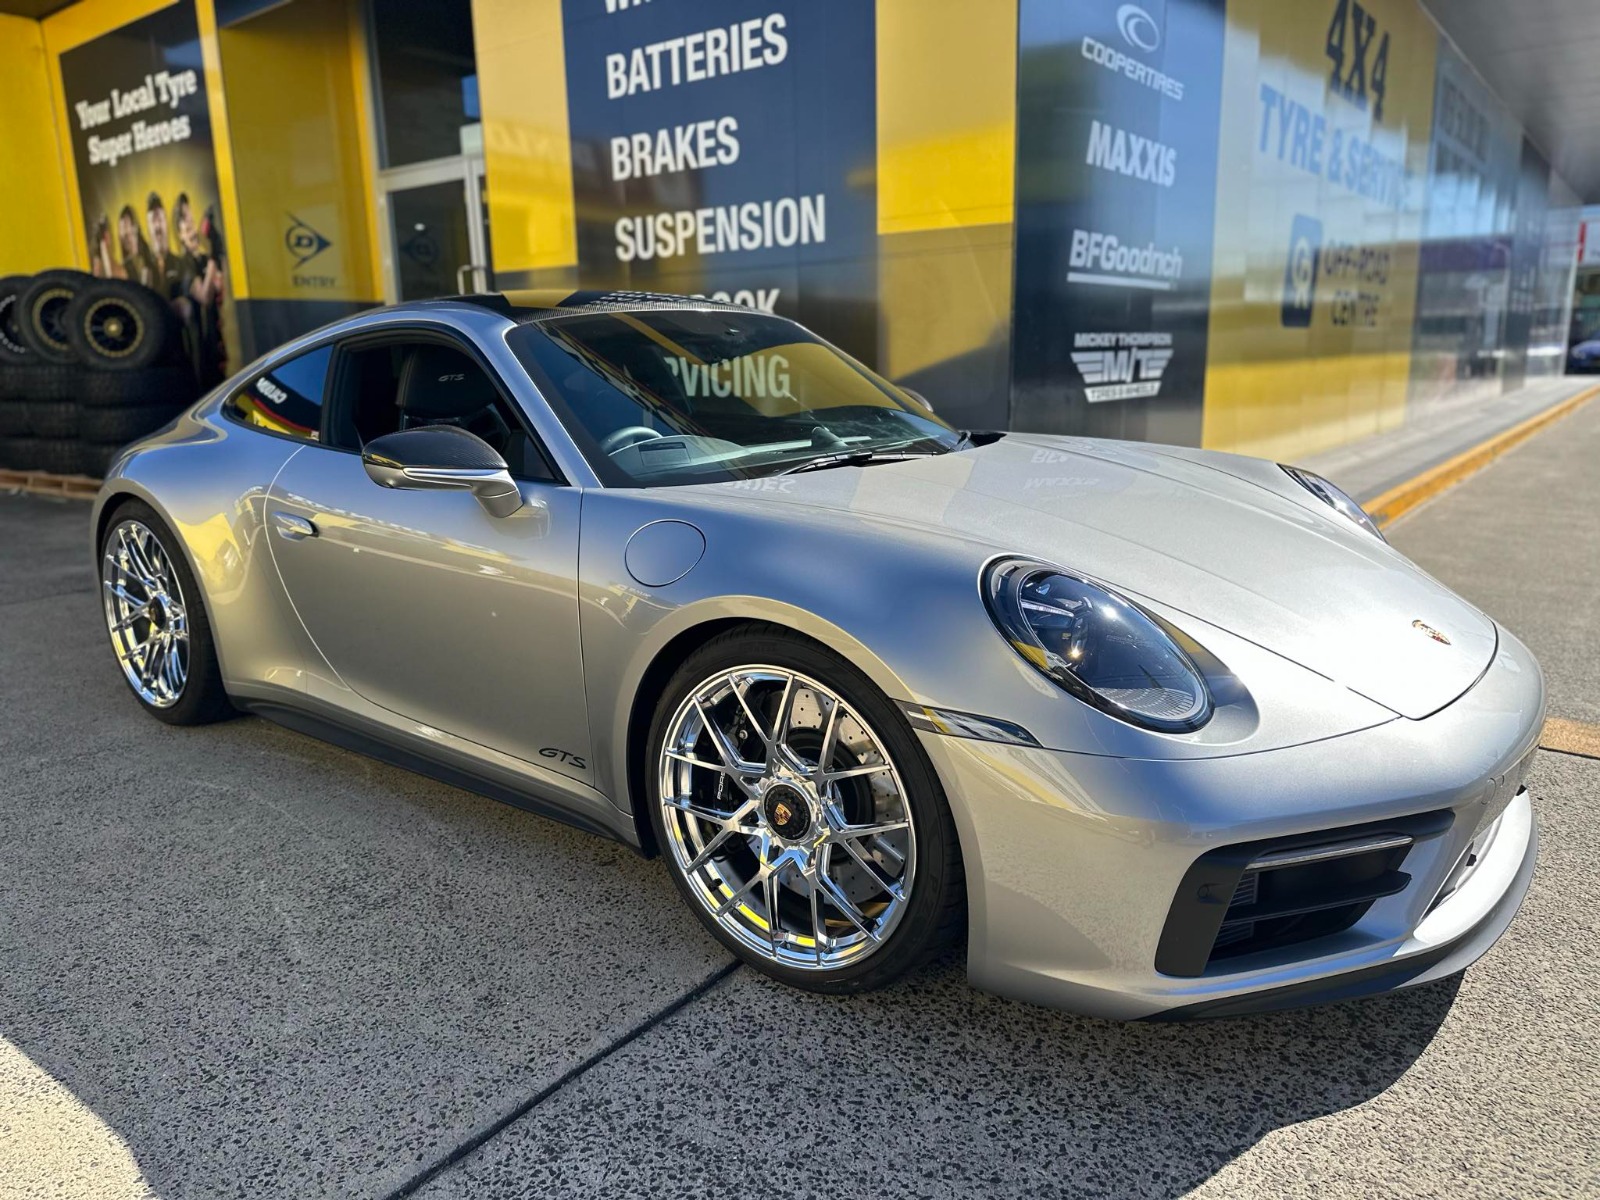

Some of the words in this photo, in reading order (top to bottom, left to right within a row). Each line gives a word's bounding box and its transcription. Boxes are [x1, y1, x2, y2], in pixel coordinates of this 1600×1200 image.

[605, 12, 788, 100] BATTERIES
[75, 100, 112, 130] Your
[110, 74, 157, 119] Local
[154, 69, 197, 109] Tyre
[87, 131, 133, 167] Super
[131, 114, 191, 151] Heroes
[610, 116, 740, 181] BRAKES
[1085, 119, 1177, 188] MAXXIS
[1259, 82, 1327, 176] TYRE
[1328, 128, 1344, 184] &
[614, 194, 826, 262] SUSPENSION
[1069, 229, 1183, 279] BFGoodrich
[292, 275, 336, 287] ENTRY
[438, 373, 465, 382] GTS
[538, 747, 587, 770] GTS
